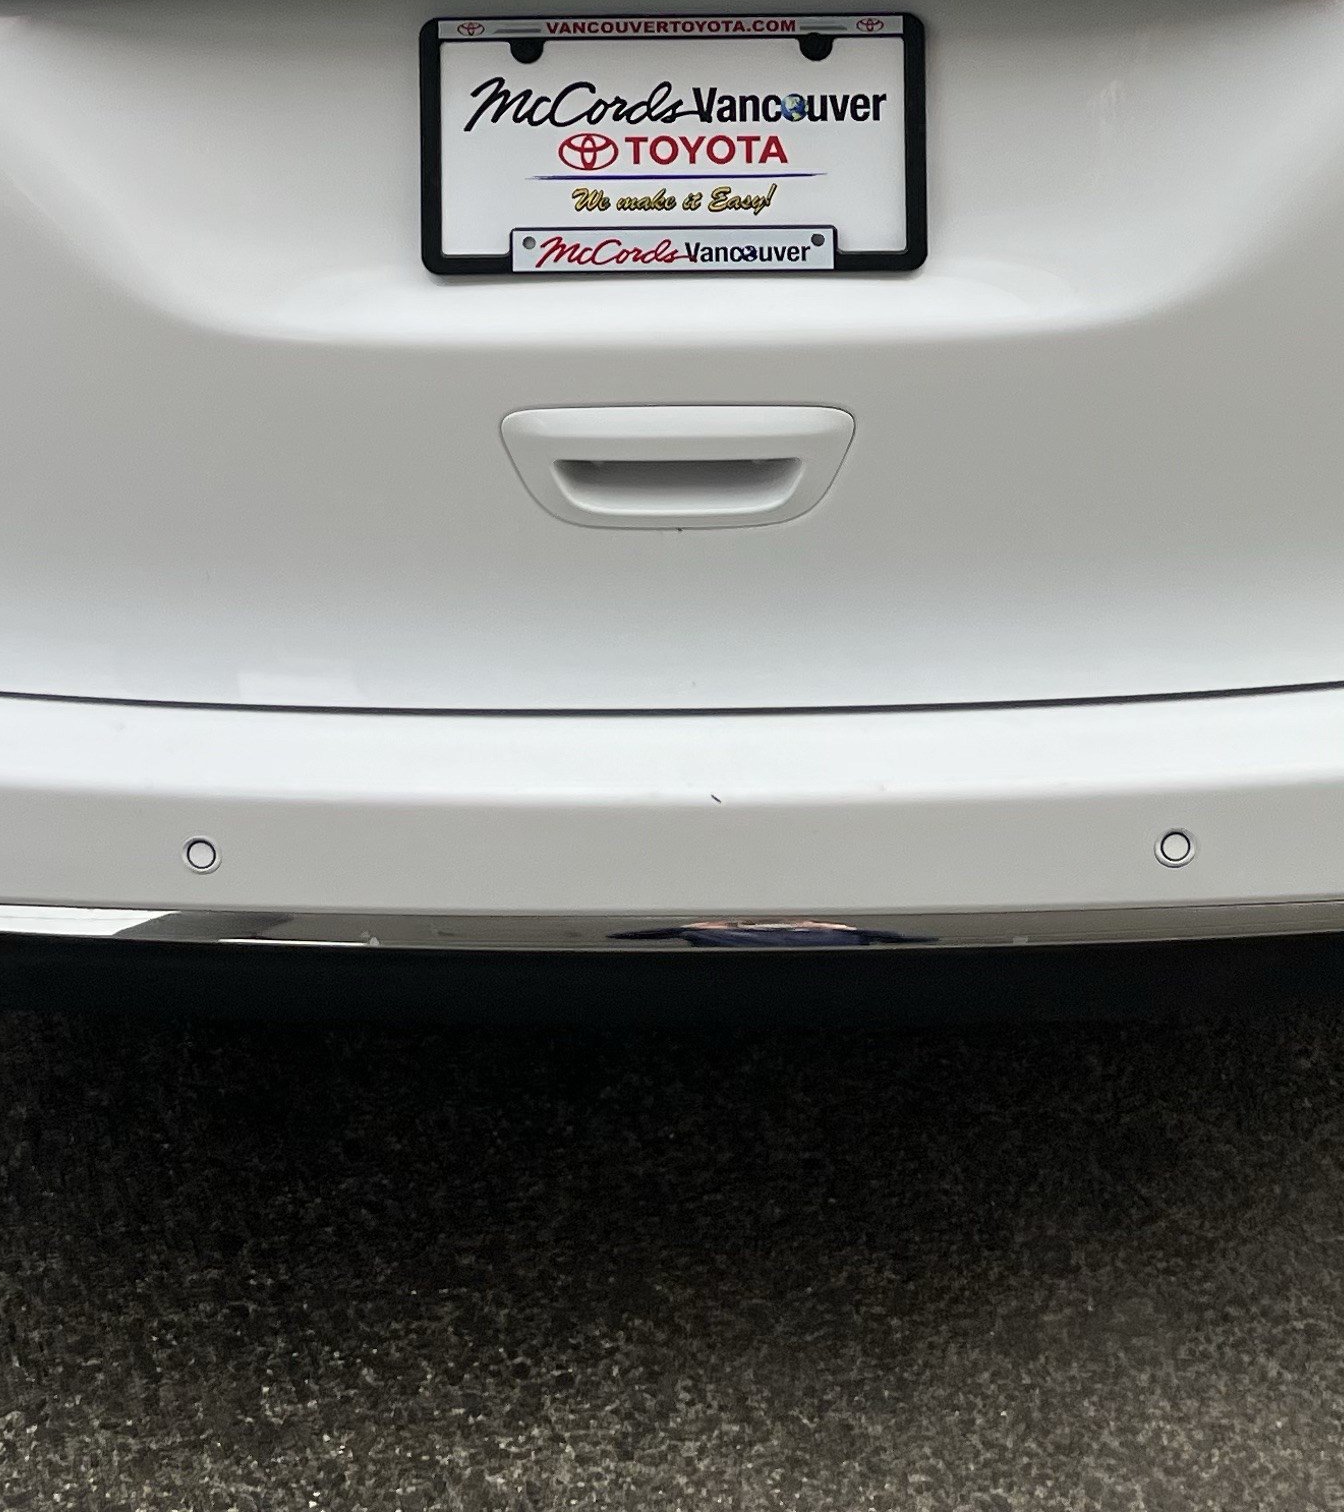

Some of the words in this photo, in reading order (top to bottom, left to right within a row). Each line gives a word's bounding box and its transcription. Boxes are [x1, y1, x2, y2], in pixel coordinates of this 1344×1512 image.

[546, 19, 797, 35] VANCOUVERTOYOTA.COM
[625, 135, 788, 165] TOYOTA
[572, 187, 611, 211] We
[616, 188, 677, 211] make
[682, 191, 703, 211] it
[708, 183, 778, 216] Easy!
